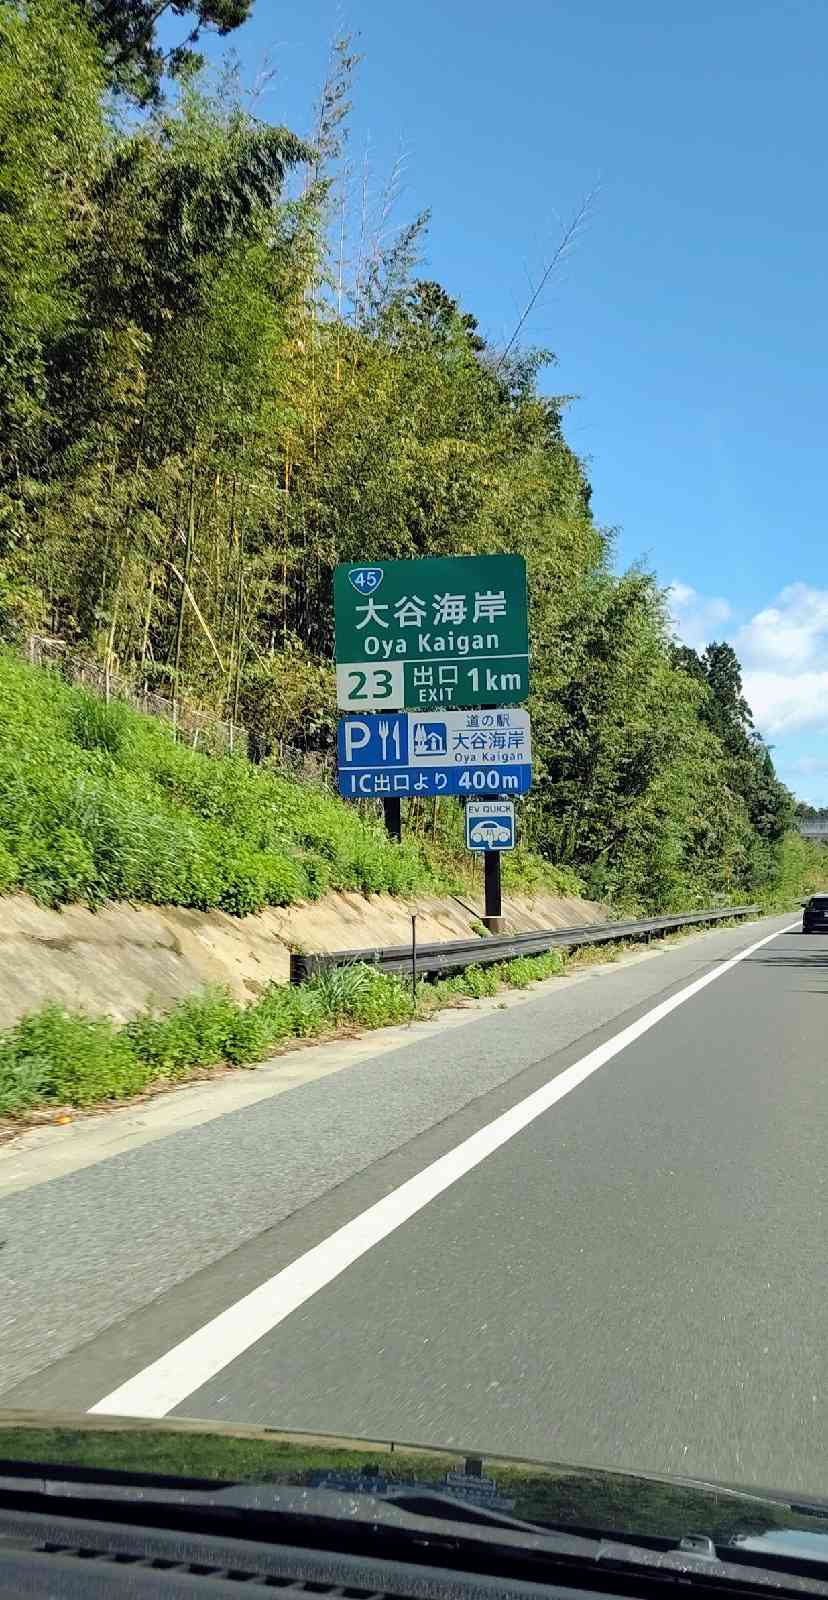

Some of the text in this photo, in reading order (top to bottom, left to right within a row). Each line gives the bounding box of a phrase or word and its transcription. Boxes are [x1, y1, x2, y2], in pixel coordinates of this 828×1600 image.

[354, 571, 377, 587] 45
[355, 590, 507, 630] 大谷海岸
[364, 631, 499, 659] Oya Kaigan
[348, 669, 393, 700] 23
[413, 665, 459, 687] 出口
[419, 687, 454, 702] EXIT
[465, 713, 511, 728] 道の駅
[343, 721, 371, 762] P
[452, 730, 525, 750] 大谷海岸
[454, 751, 524, 764] Oya Kaigan
[350, 772, 448, 793] IC出口より
[458, 770, 519, 790] 400m
[468, 804, 512, 814] EV QUICK
